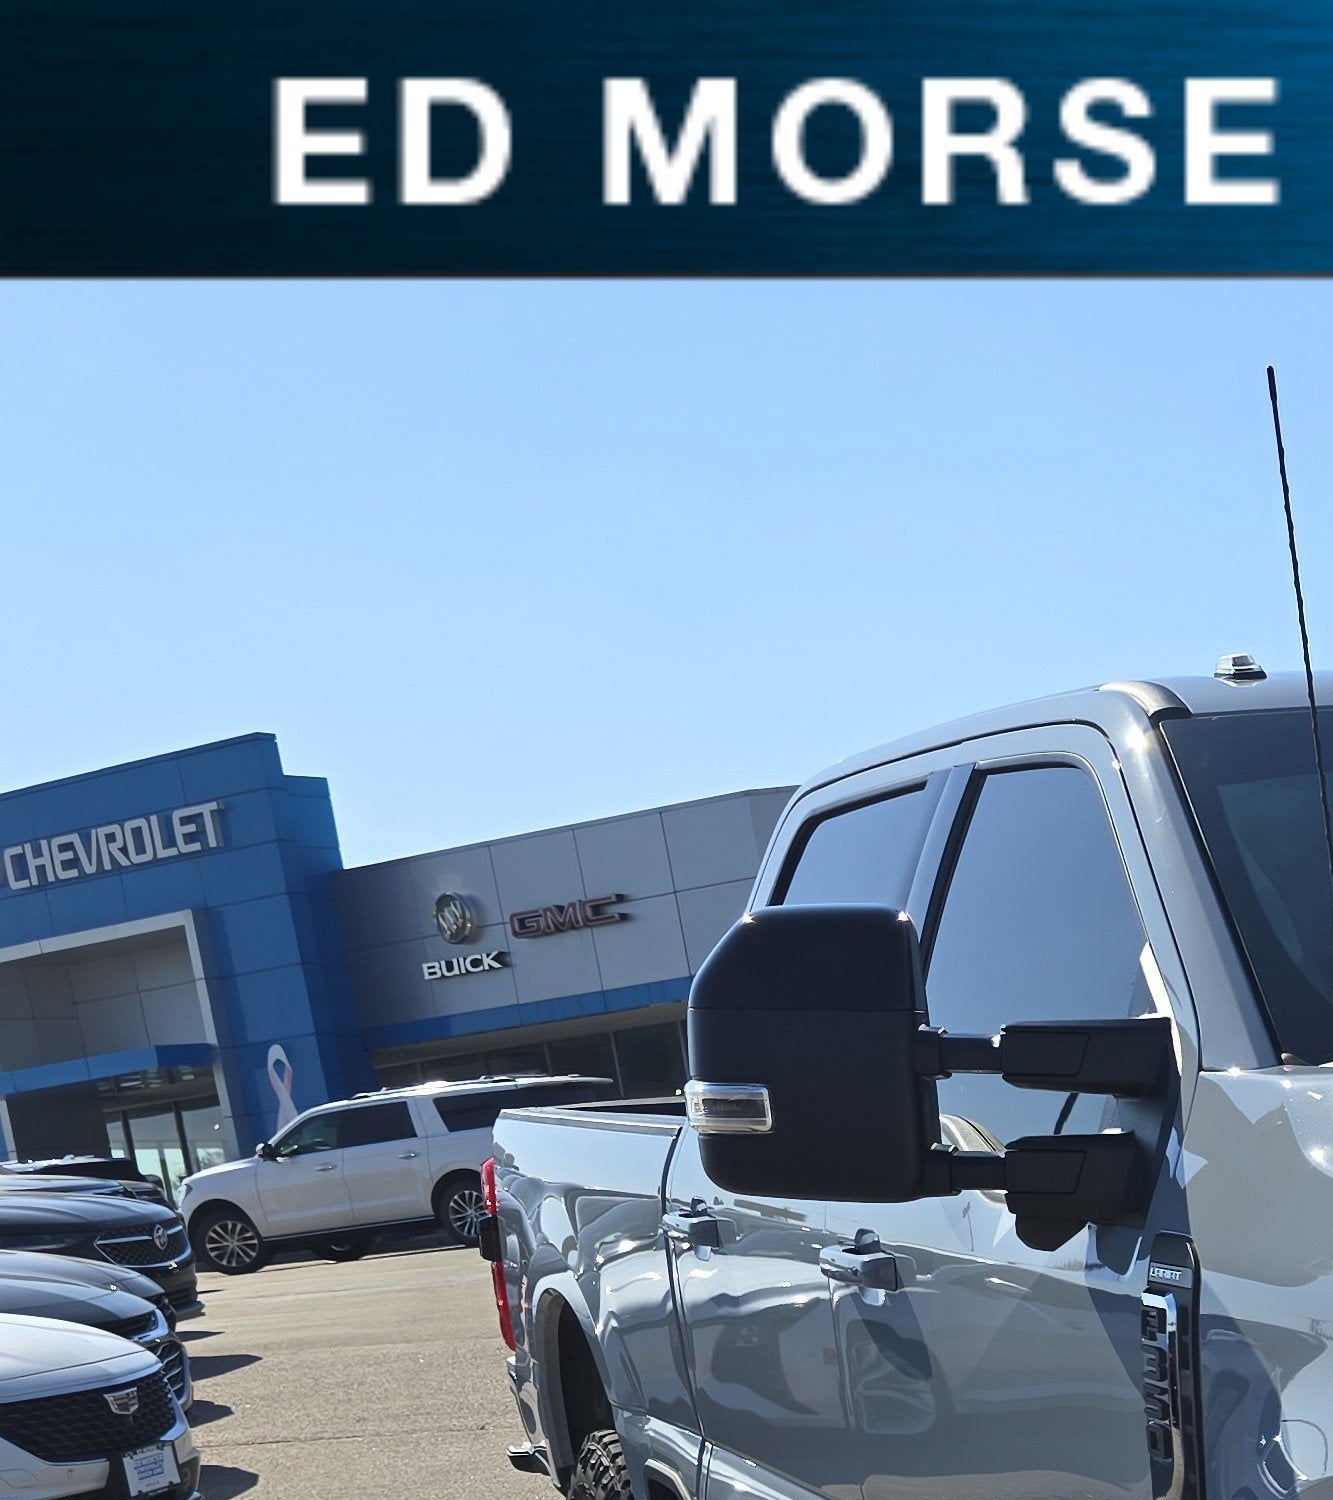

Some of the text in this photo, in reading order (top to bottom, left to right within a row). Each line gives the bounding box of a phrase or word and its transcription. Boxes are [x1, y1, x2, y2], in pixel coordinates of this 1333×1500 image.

[3, 801, 219, 891] CHEVROLET
[509, 893, 621, 939] GMC
[421, 950, 502, 980] BUICK
[1150, 1266, 1183, 1281] LARIAT
